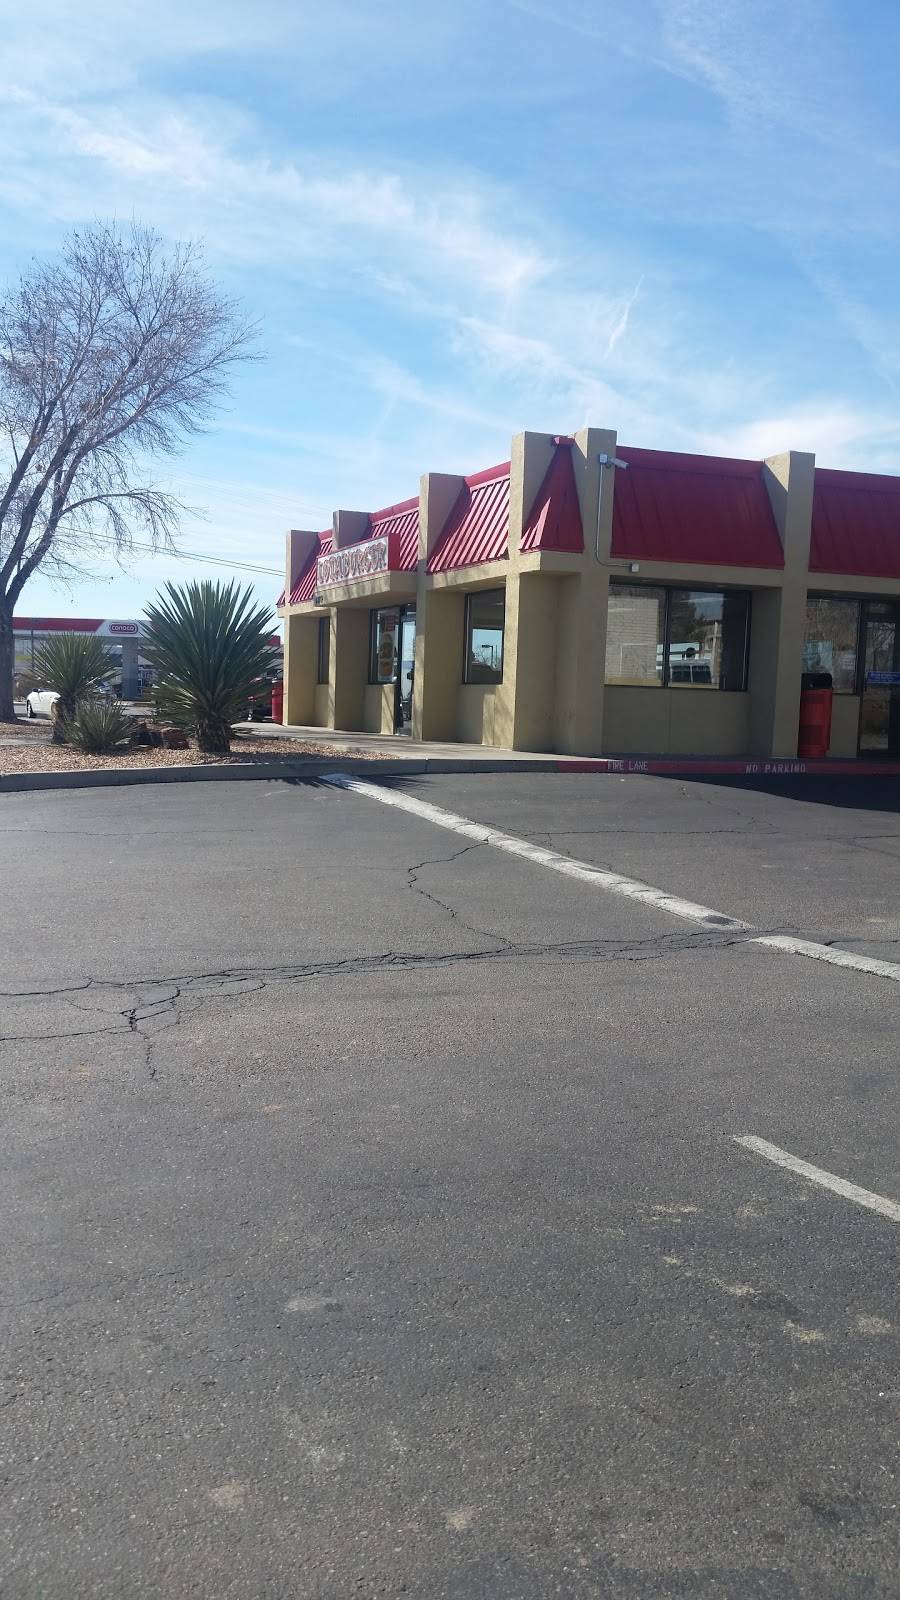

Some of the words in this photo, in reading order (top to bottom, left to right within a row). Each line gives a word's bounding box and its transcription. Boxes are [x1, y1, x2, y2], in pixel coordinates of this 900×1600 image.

[607, 760, 624, 770] FIRE
[628, 760, 648, 770] LANE
[745, 764, 757, 774] NO
[765, 763, 806, 773] PARKING
